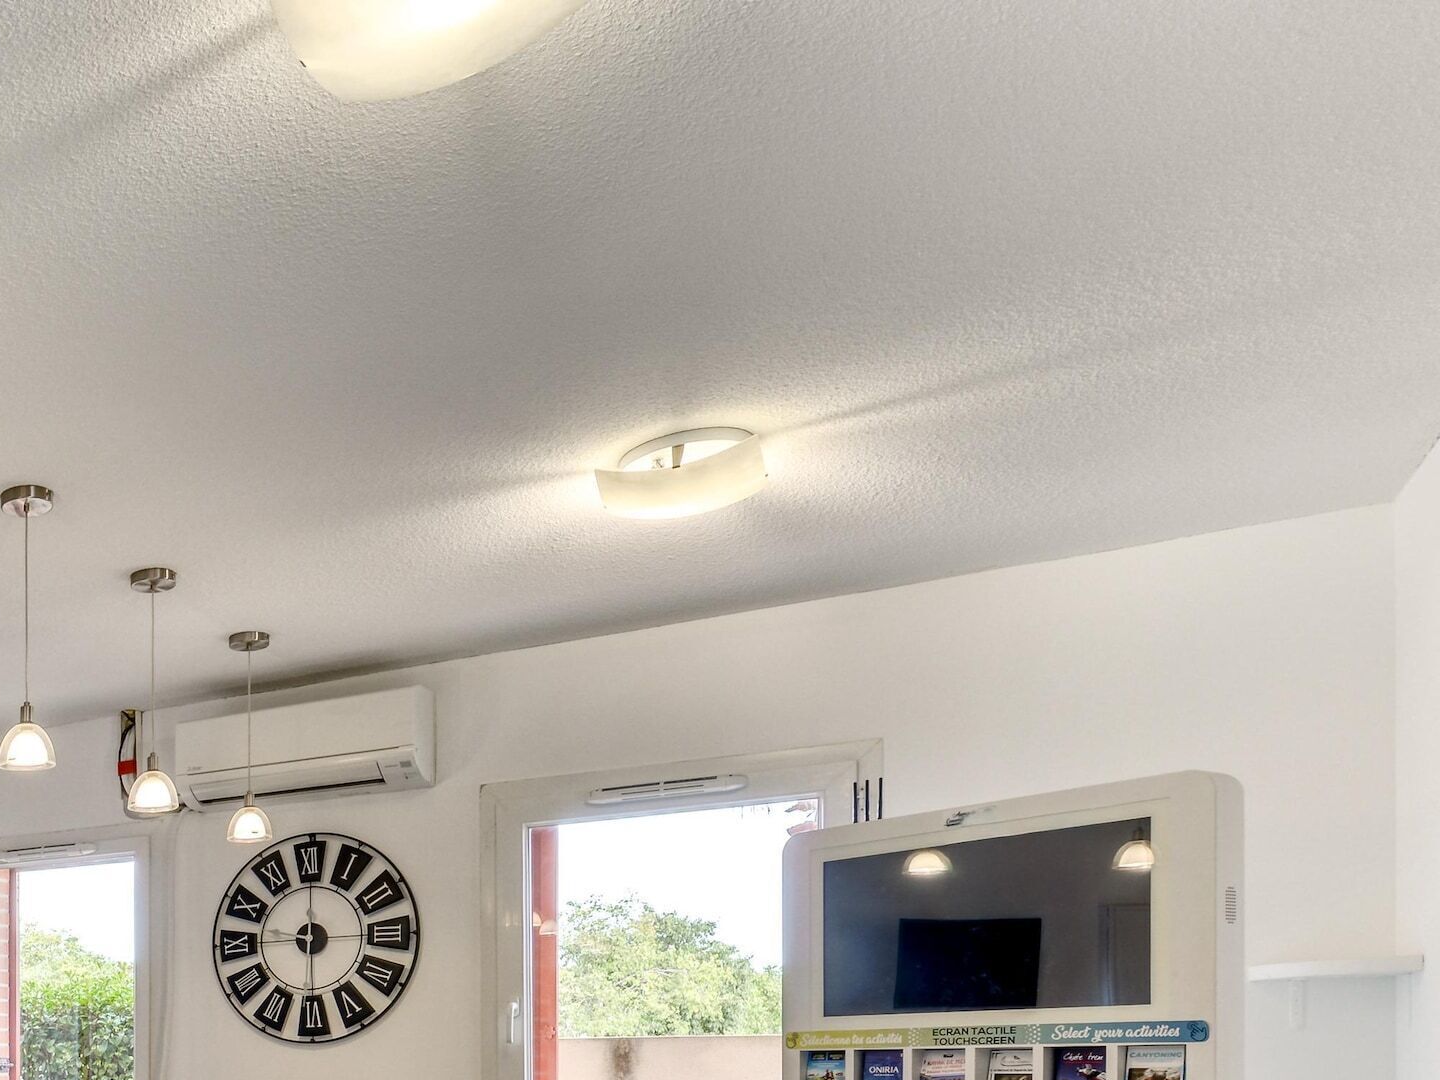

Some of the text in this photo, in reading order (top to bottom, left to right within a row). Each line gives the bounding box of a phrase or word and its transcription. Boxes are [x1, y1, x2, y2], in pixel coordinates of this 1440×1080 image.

[932, 1026, 1017, 1036] ECRAN TACTILE
[1051, 1024, 1180, 1043] Select your activities
[933, 1036, 1016, 1046] TOUCHSCREEN
